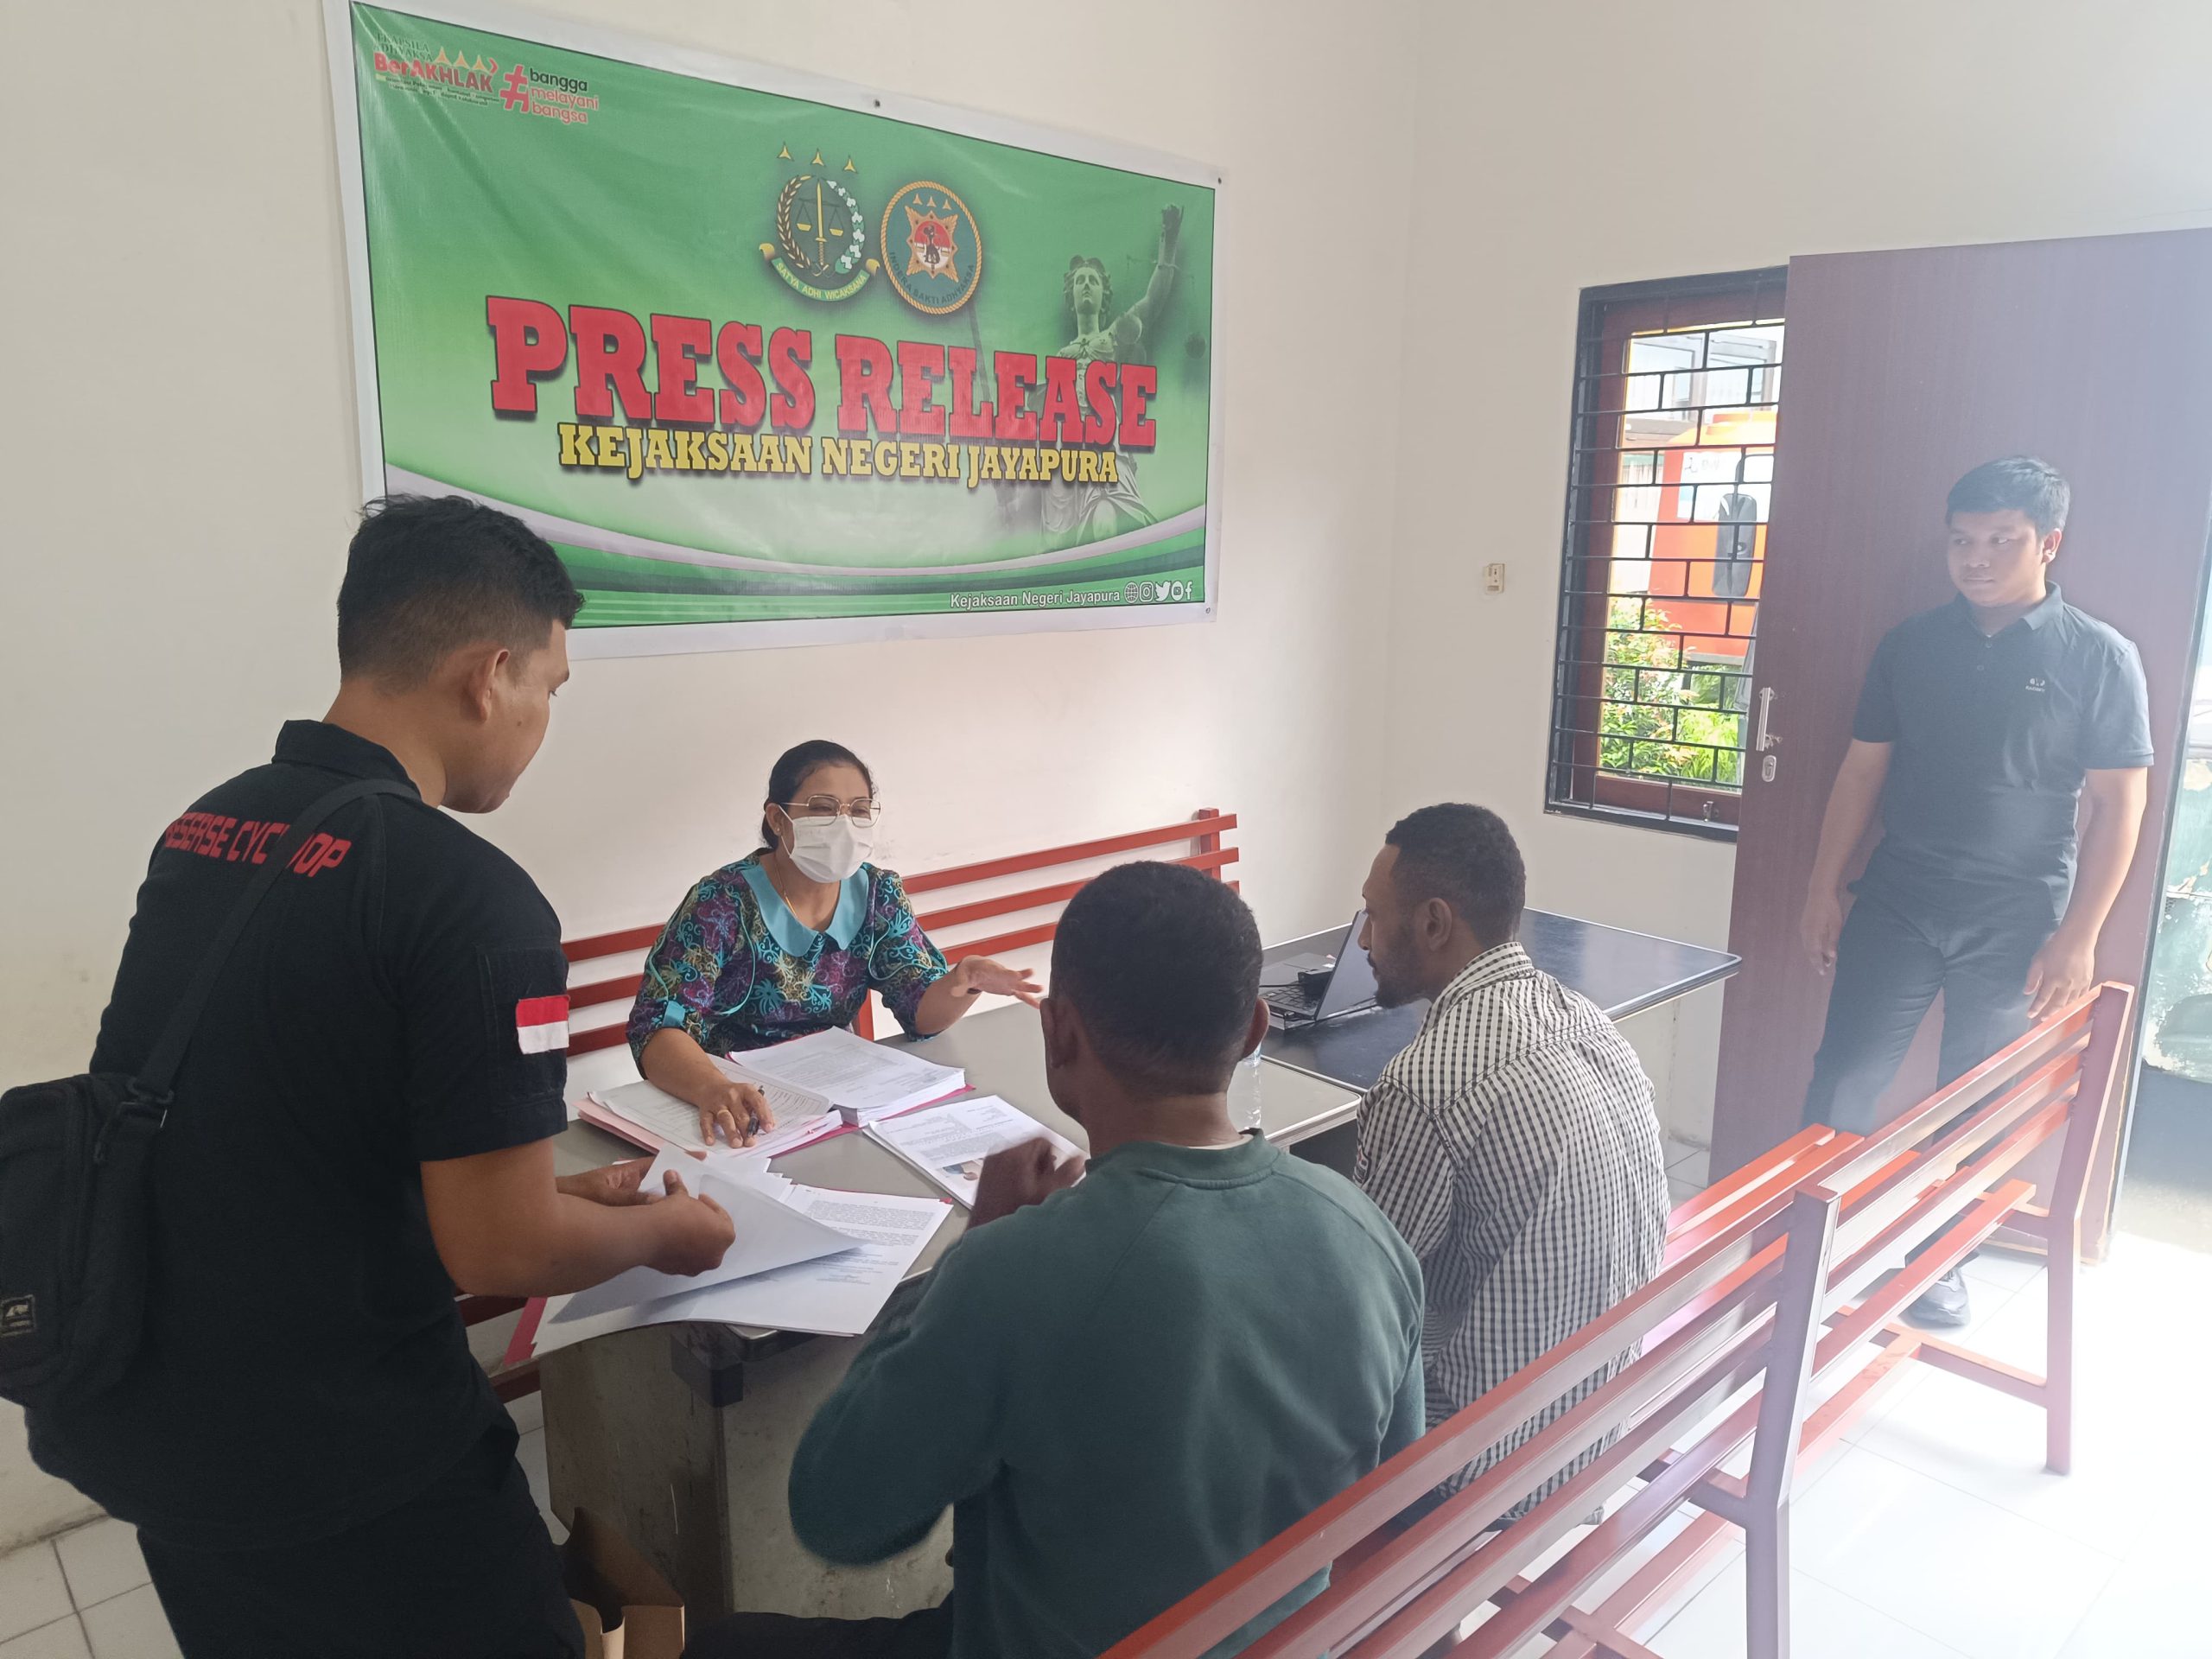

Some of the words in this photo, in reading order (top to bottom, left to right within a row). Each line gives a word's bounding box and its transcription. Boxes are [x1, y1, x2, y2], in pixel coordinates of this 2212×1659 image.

[374, 52, 493, 93] BerAKHLAK
[530, 67, 588, 94] bangga
[531, 87, 599, 110] melayani
[532, 102, 588, 124] bangsa
[776, 262, 800, 289] SATYA
[801, 285, 822, 298] ADHI
[824, 275, 867, 300] WICAKSANA
[486, 296, 816, 429] PRESS
[835, 334, 1157, 446] RELEASE
[557, 423, 813, 480] KEJAKSAAN
[821, 436, 961, 479] NEGERI
[967, 444, 1119, 488] JAYAPURA
[950, 593, 1018, 610] Kejaksaan
[1021, 590, 1064, 607] Negeri
[1066, 588, 1121, 605] Jayapura
